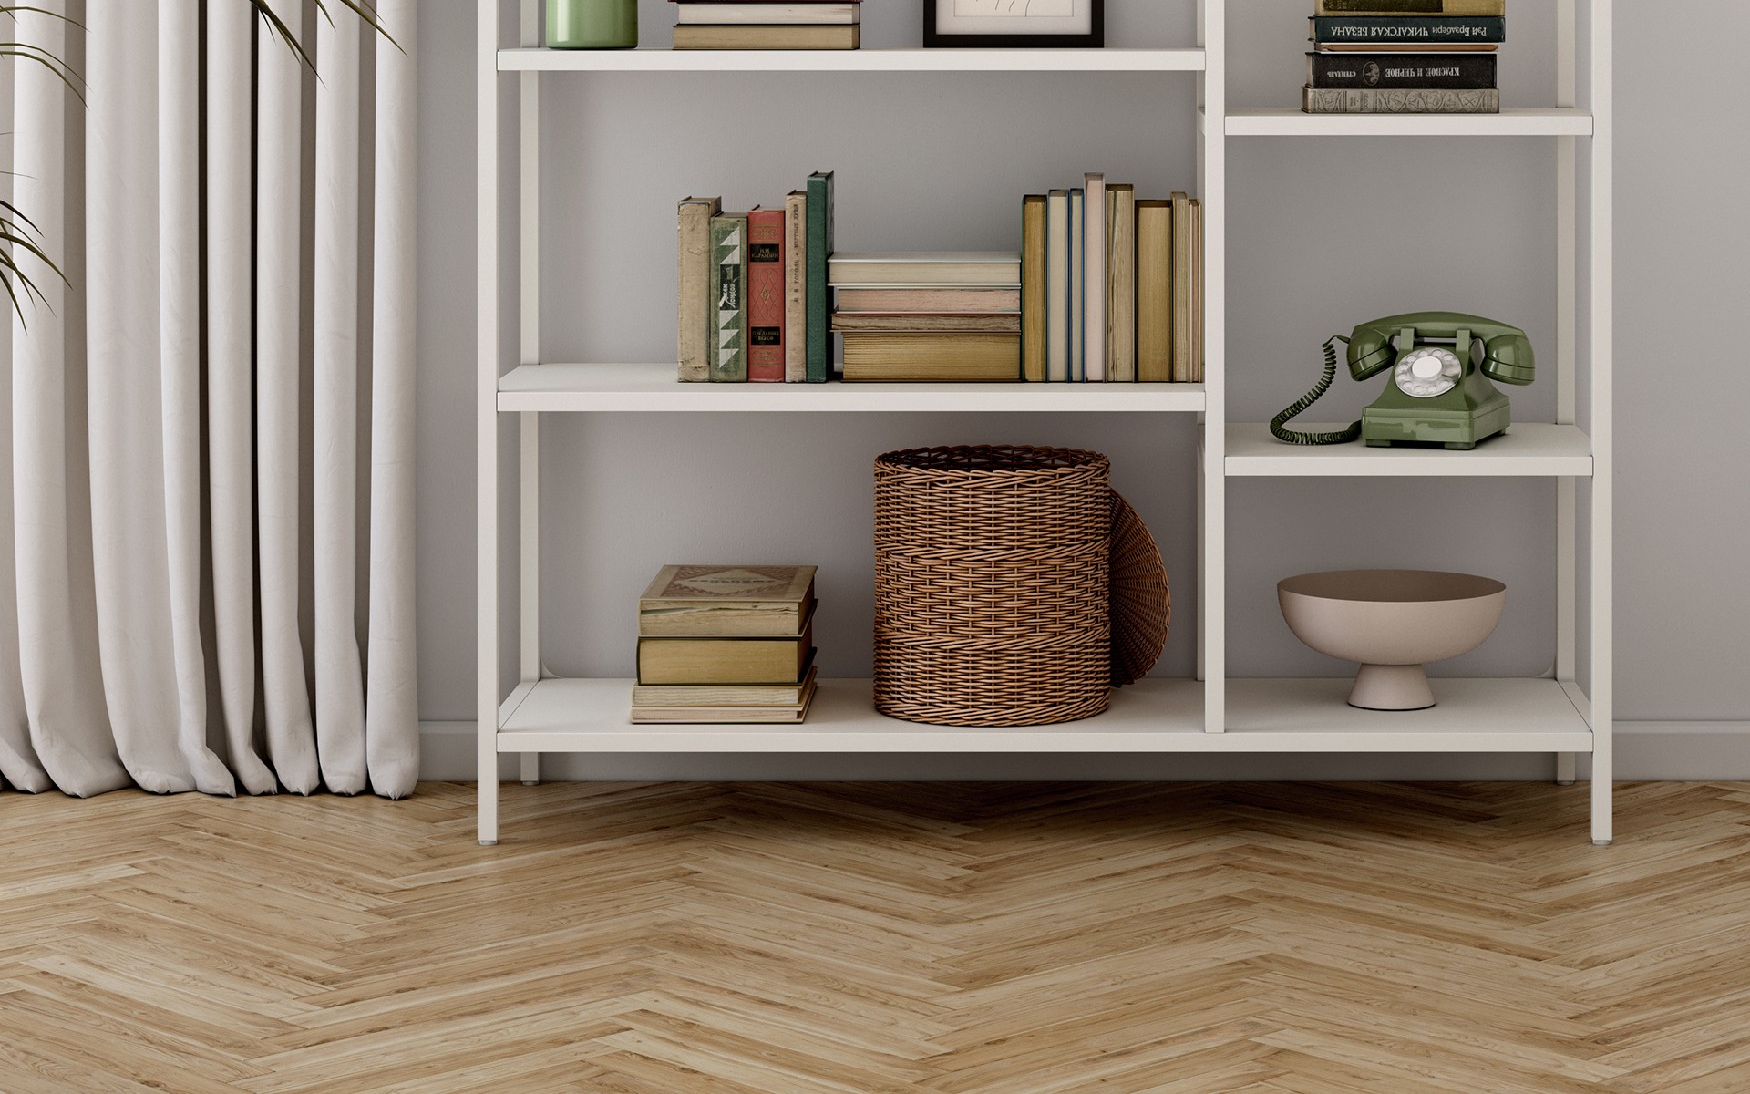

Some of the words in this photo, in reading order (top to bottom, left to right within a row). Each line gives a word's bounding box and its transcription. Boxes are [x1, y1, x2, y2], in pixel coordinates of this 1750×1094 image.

[1331, 26, 1368, 36] БЕЗДНА
[1371, 26, 1428, 36] ЧИКАГСКАЯ
[1432, 24, 1470, 36] Брэдбери
[1472, 26, 1487, 36] Рэй
[1385, 67, 1416, 77] ЧЕРНОЕ
[1425, 67, 1460, 77] КРАСНОЕ
